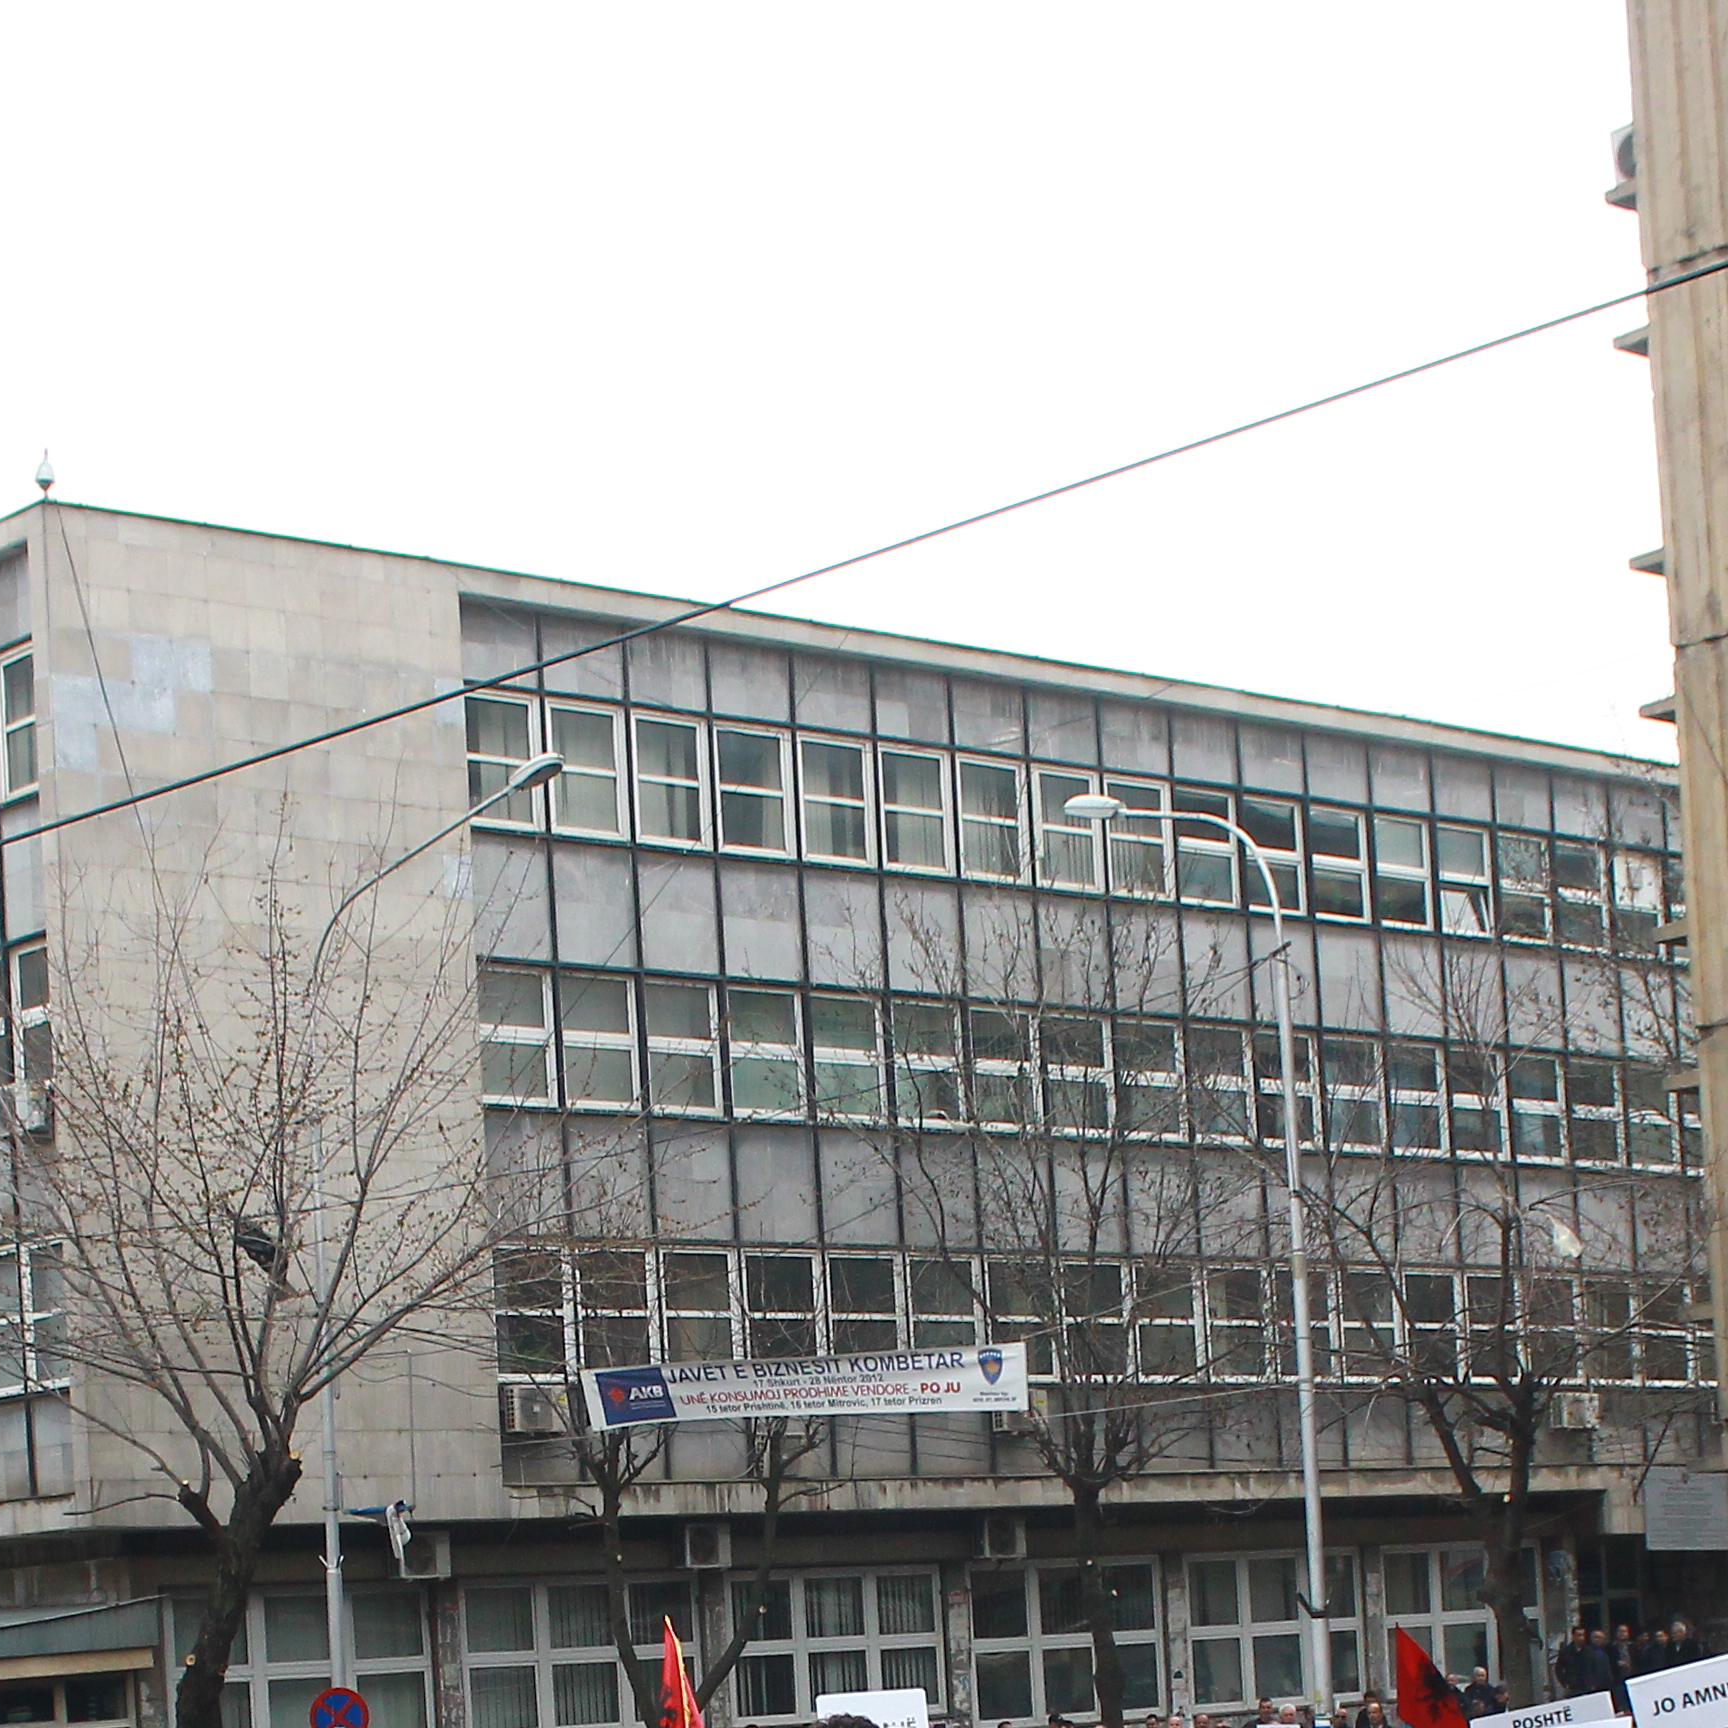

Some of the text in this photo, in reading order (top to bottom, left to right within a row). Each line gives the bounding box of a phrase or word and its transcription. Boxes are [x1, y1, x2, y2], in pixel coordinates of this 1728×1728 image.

[733, 1364, 749, 1380] E
[753, 1358, 842, 1378] BIZNESIT
[629, 1385, 664, 1401] AKB
[710, 1389, 781, 1403] KONSUMOJ
[783, 1386, 849, 1400] PRODHIME
[851, 1383, 910, 1397] VENDORE
[920, 1383, 940, 1394] PO
[943, 1382, 961, 1393] JU
[1653, 1698, 1675, 1716] JO
